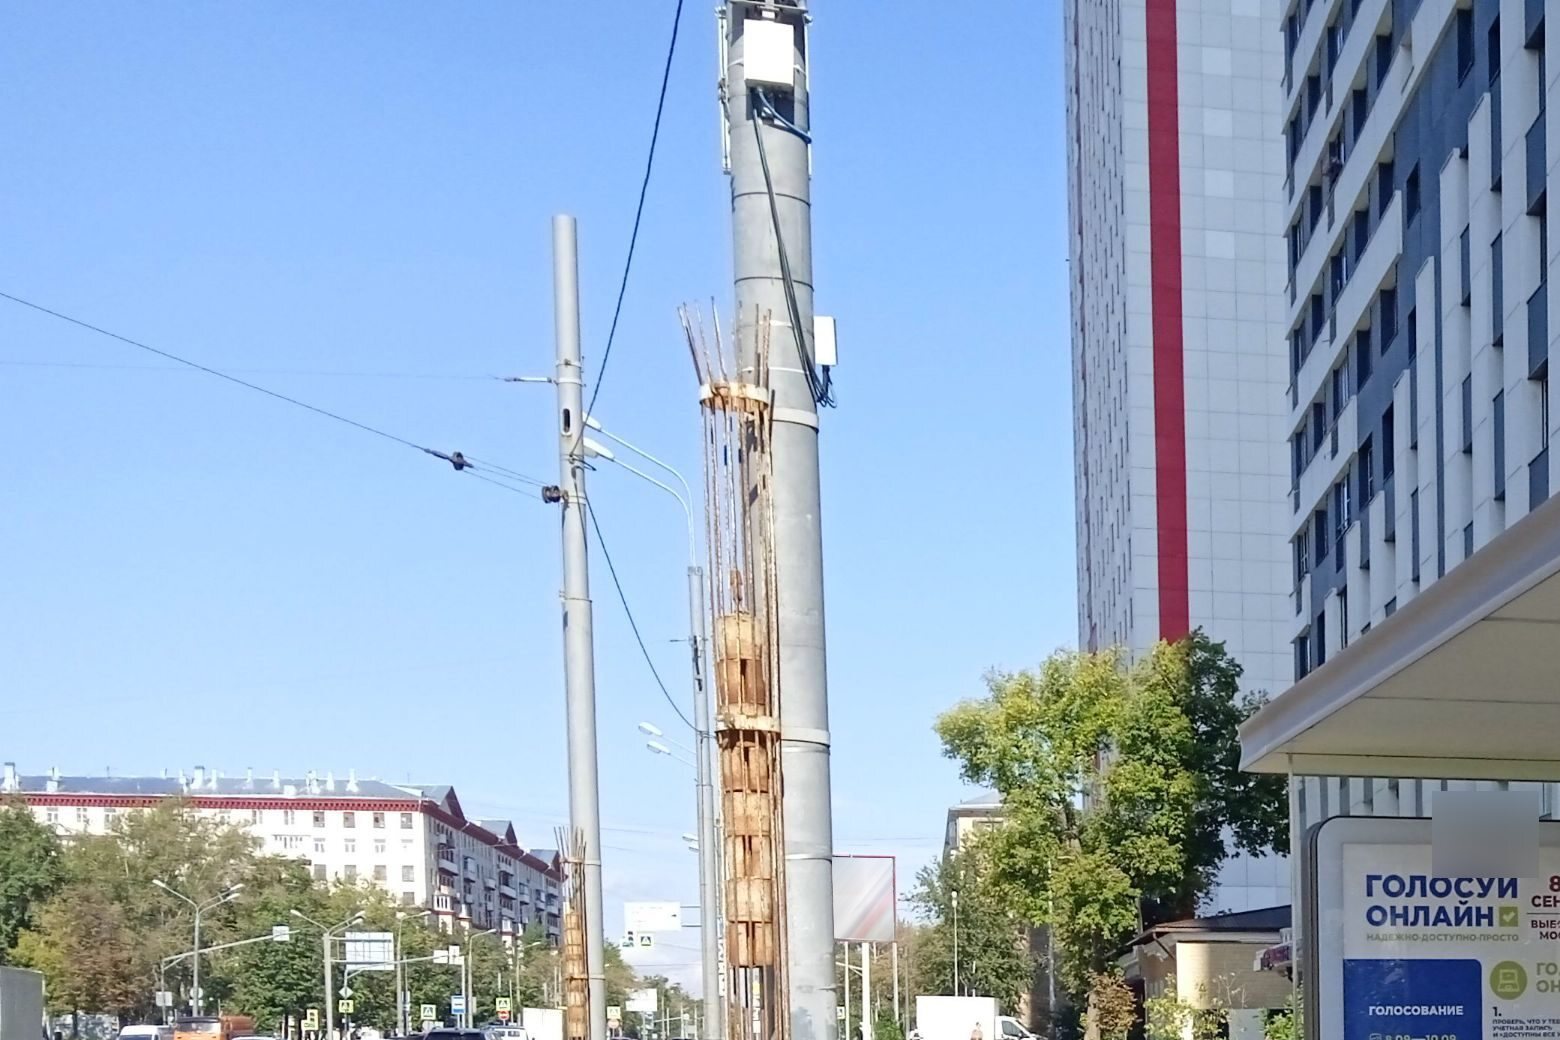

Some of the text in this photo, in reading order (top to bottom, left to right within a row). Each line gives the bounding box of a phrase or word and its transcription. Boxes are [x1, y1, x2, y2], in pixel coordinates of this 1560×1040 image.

[1366, 900, 1494, 927] ОНЛАЙН
[1368, 1006, 1464, 1016] ГОЛОСОВАНИЕ
[1493, 1006, 1502, 1016] 1.
